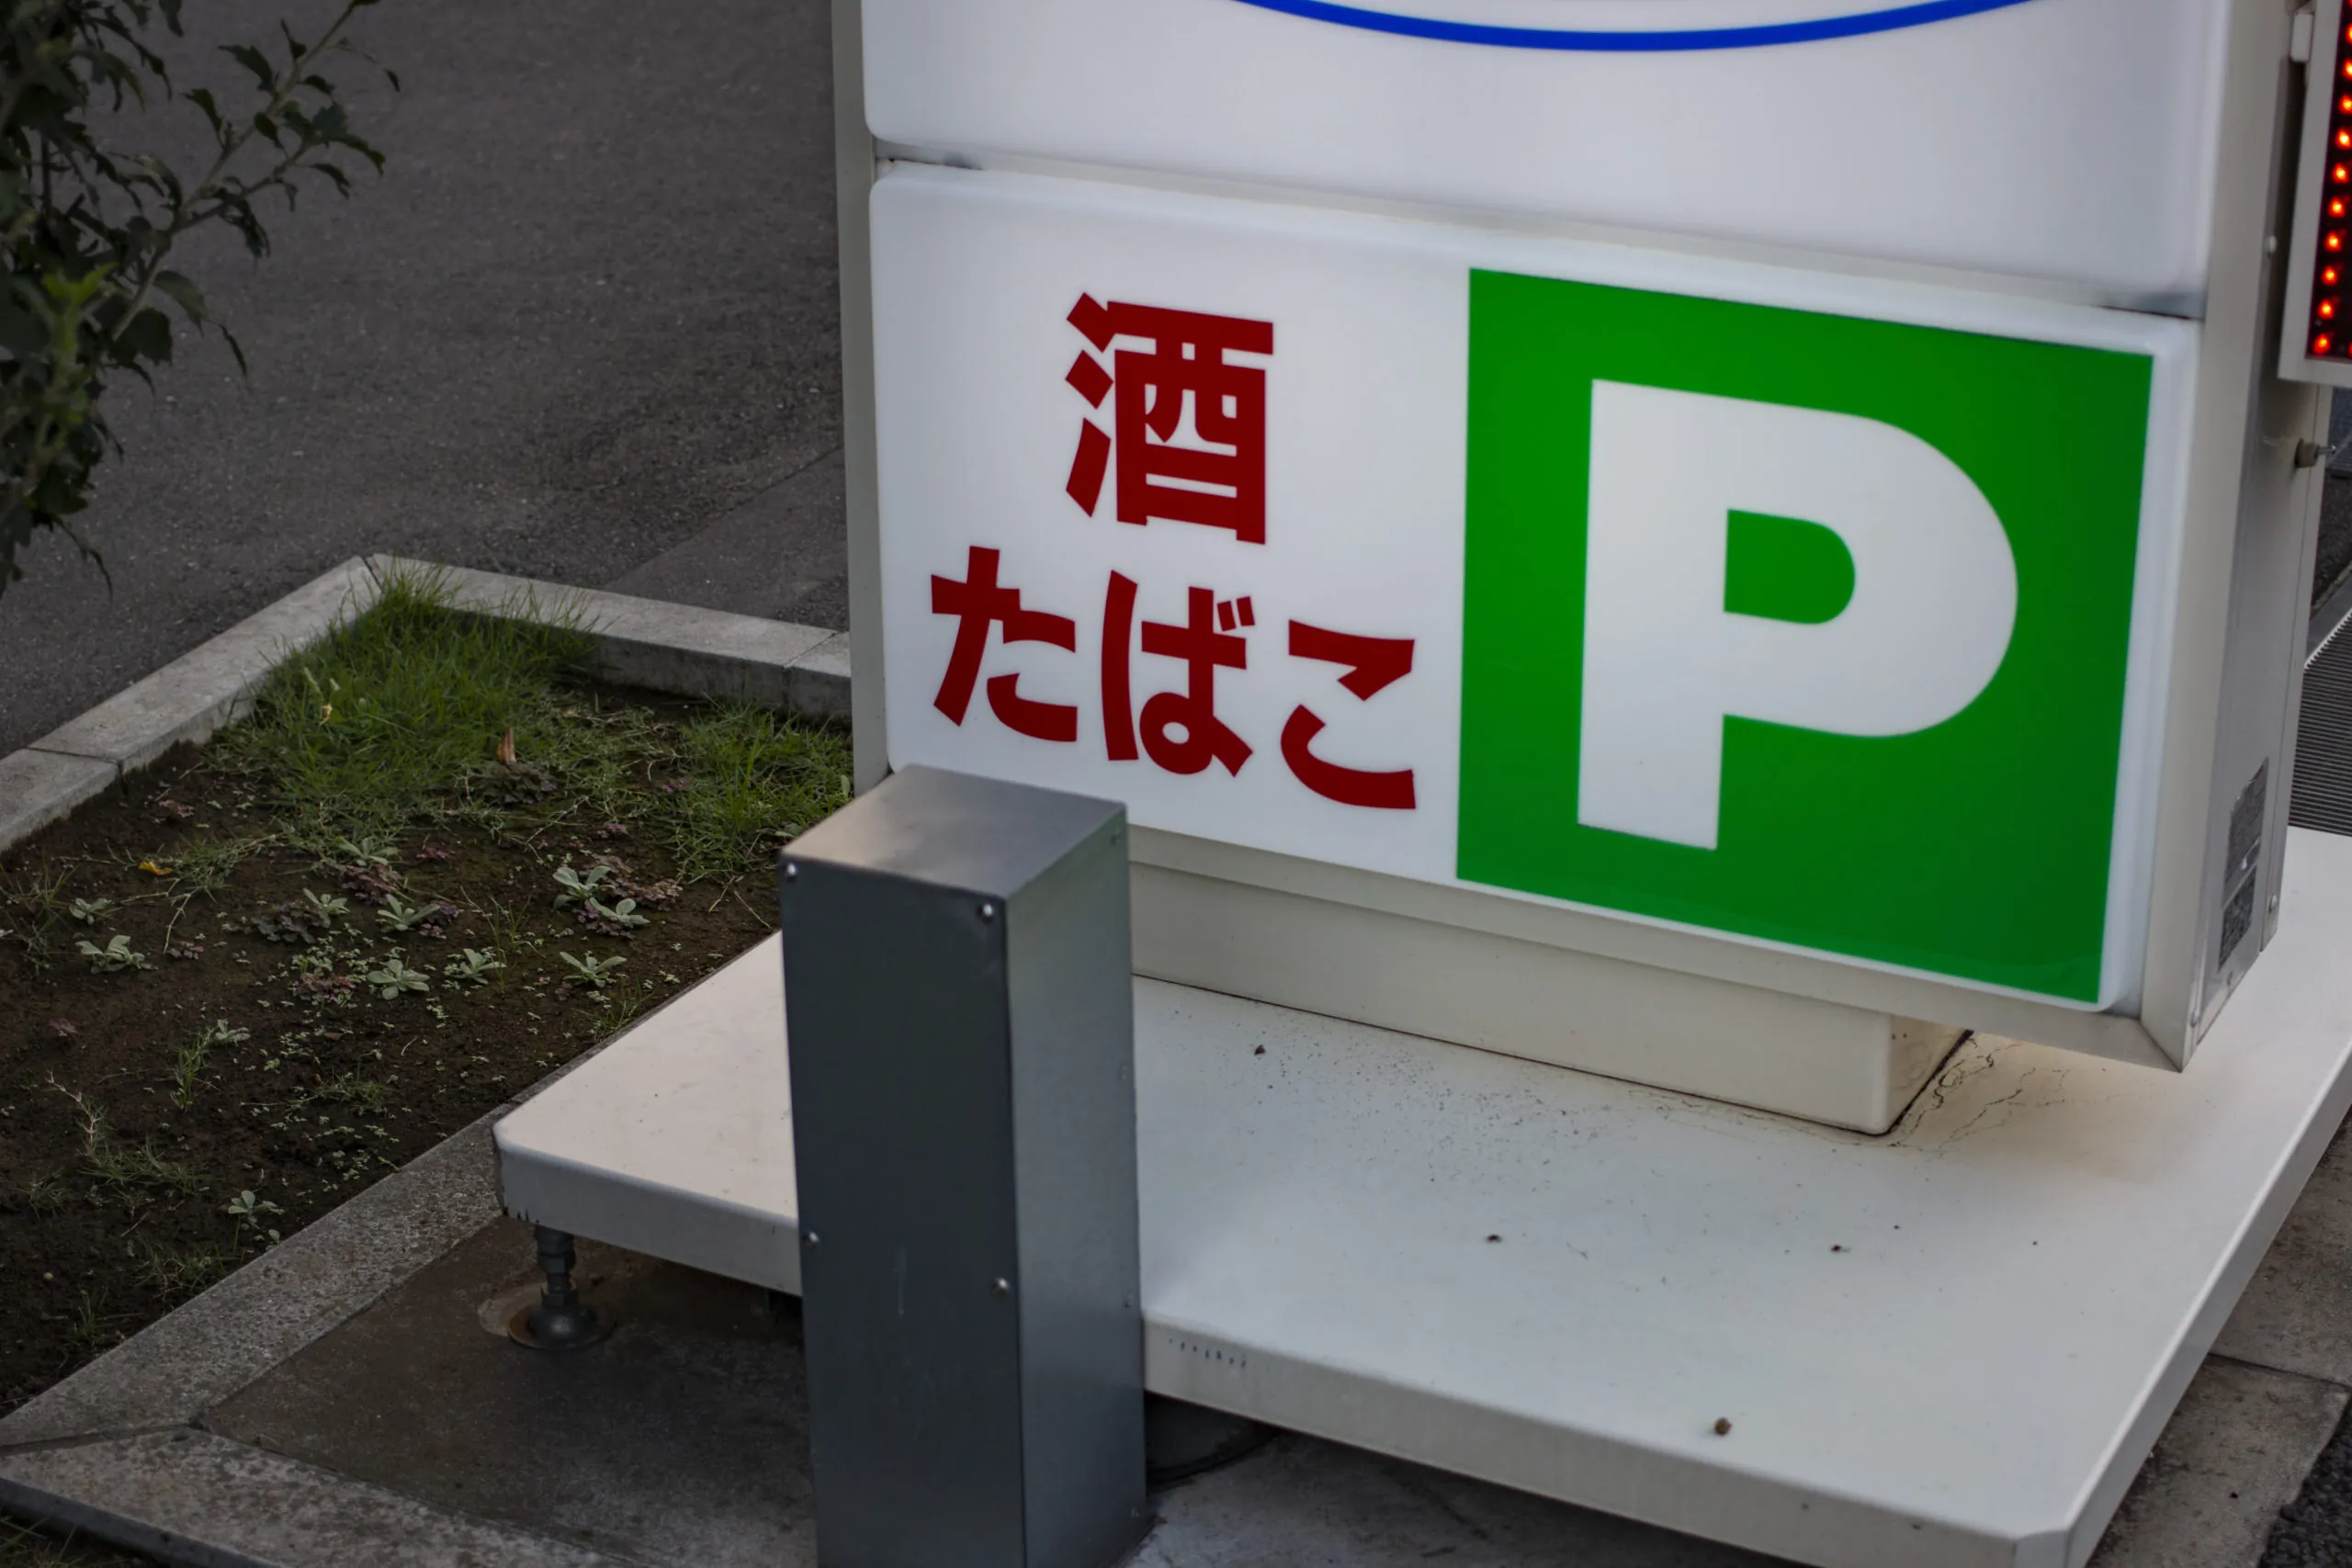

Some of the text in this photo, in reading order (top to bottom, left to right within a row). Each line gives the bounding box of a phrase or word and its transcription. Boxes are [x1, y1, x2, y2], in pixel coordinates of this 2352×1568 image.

[1067, 294, 1273, 545] 酒
[932, 547, 1416, 810] たばこ
[1578, 379, 2018, 850] P
